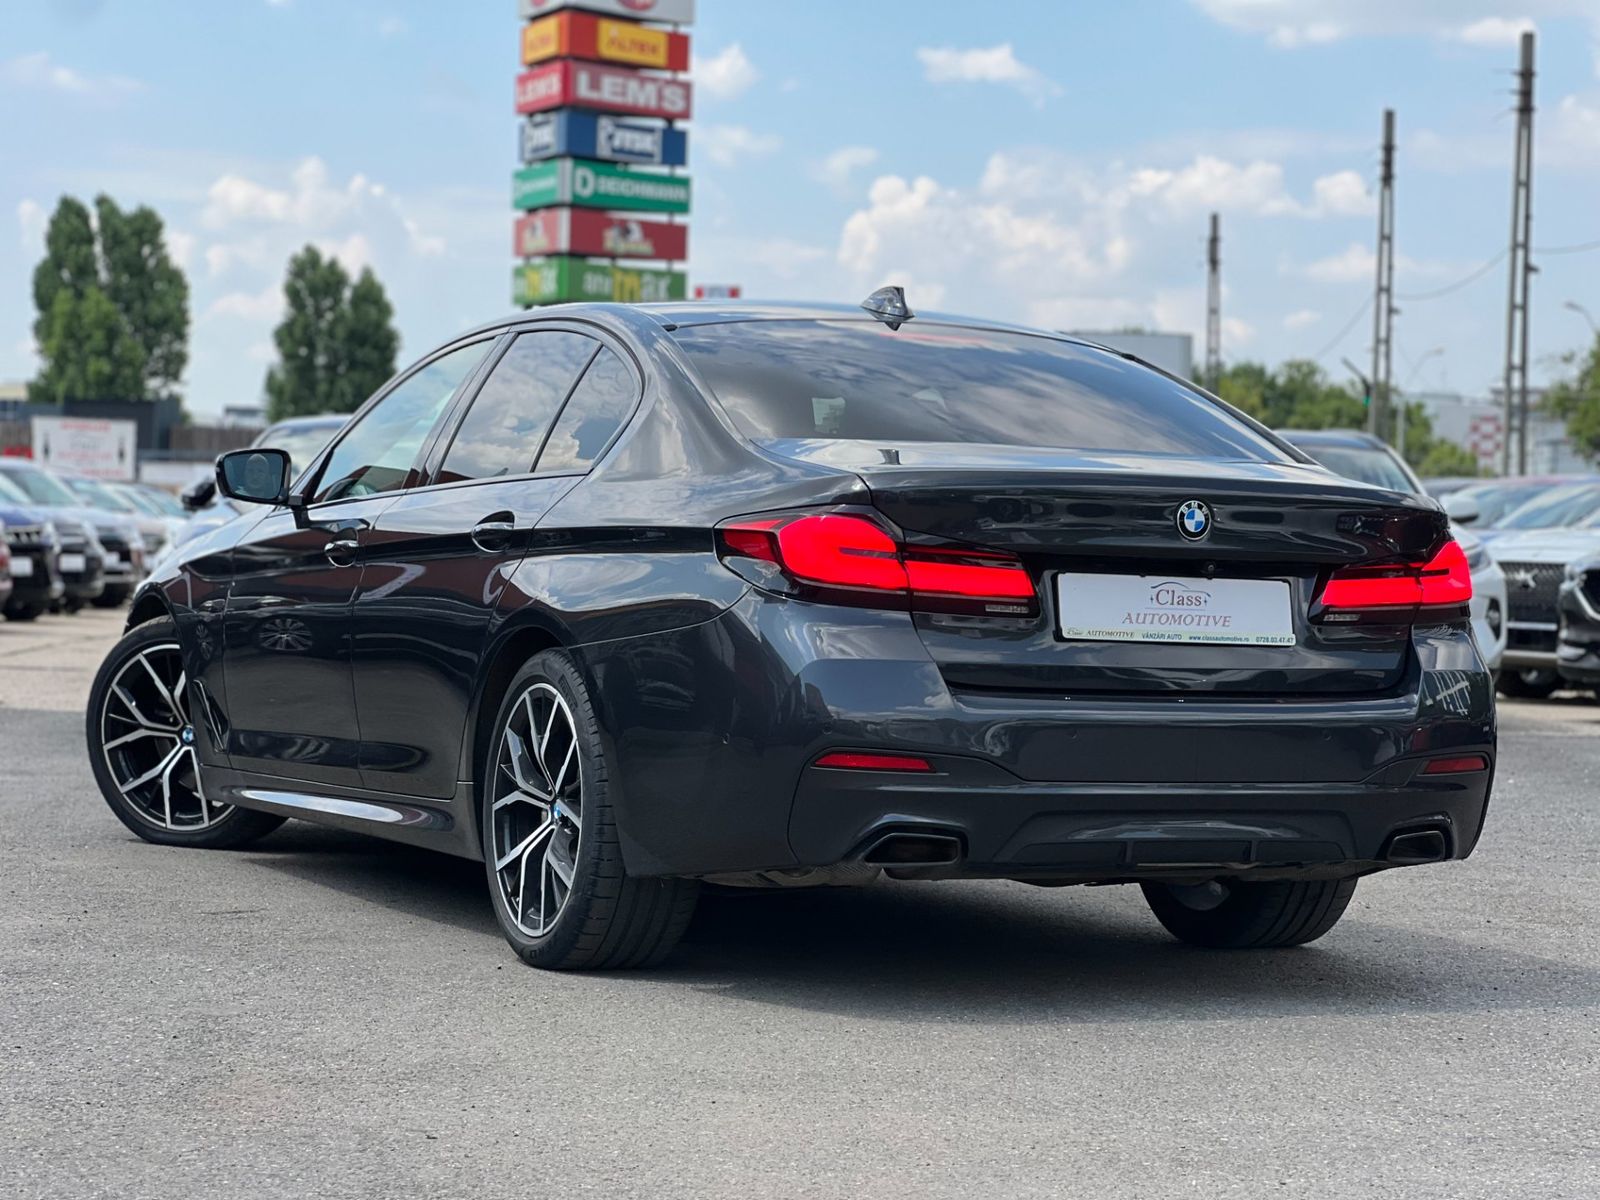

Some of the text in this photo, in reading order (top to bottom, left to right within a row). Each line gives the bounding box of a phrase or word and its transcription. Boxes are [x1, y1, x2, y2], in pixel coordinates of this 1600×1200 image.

[1156, 589, 1202, 606] Class
[1122, 612, 1231, 628] AUTOMOTIVE
[1087, 630, 1135, 638] AUTOMOTIVE
